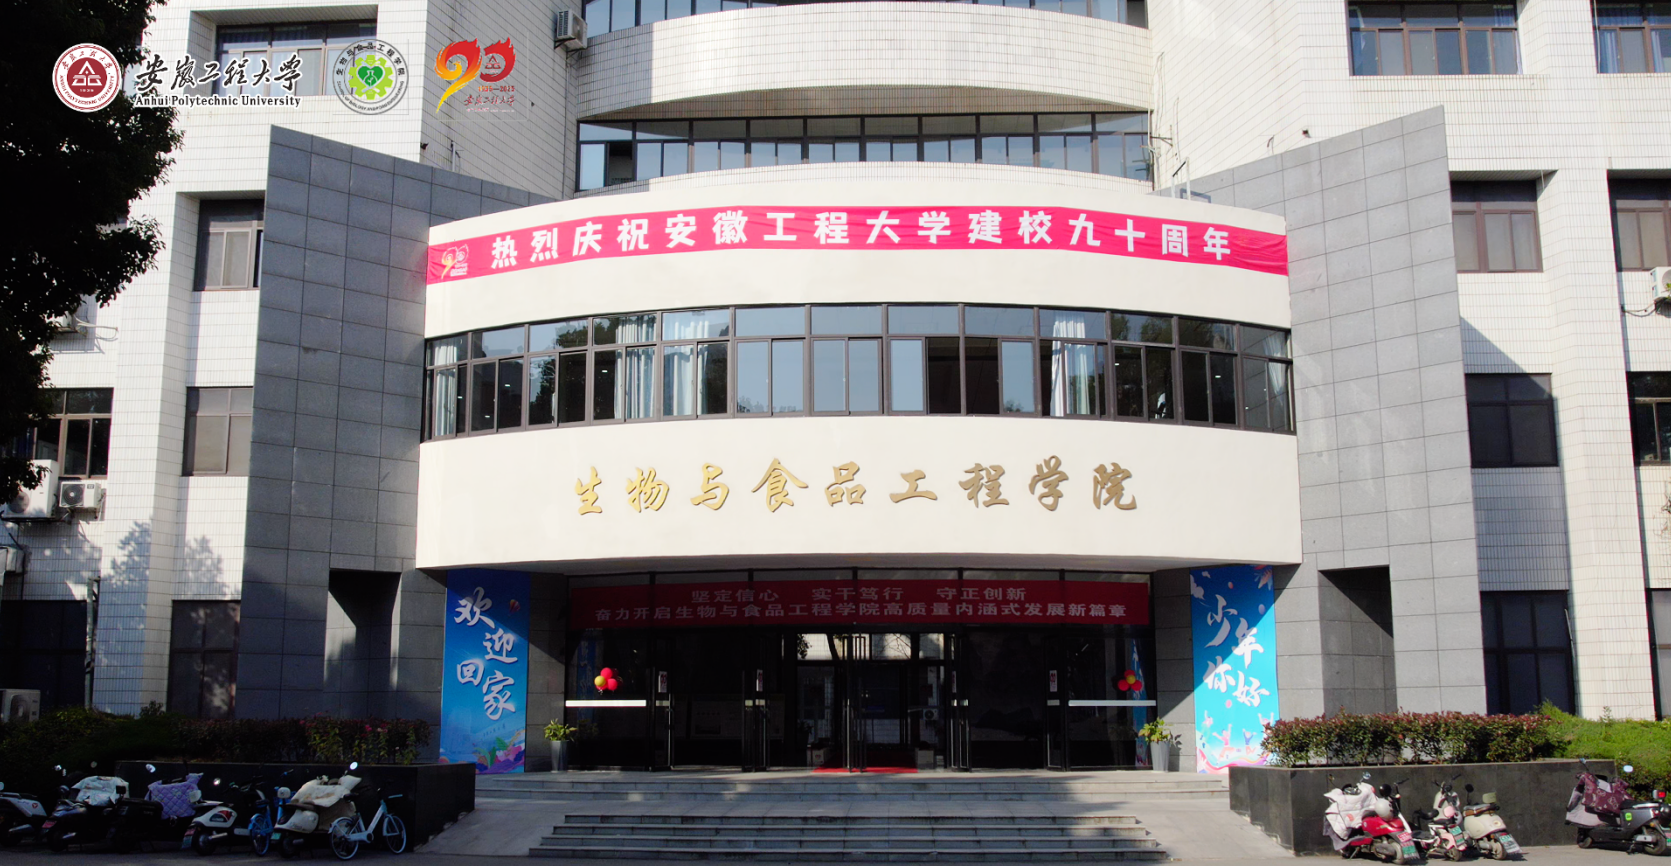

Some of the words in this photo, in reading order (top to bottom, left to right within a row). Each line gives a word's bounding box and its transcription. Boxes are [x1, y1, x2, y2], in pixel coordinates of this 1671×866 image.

[491, 210, 1231, 269] 热烈庆祝安徽工程大学建校九十周年
[574, 455, 1138, 515] 生物与食品工程学院
[595, 603, 1127, 621] 奋力开启生物与食品工程学院高质量内涵式发展新篇章
[691, 589, 780, 602] 坚定信心
[811, 588, 904, 601] 实干笃行
[936, 588, 1026, 601] 守正创新
